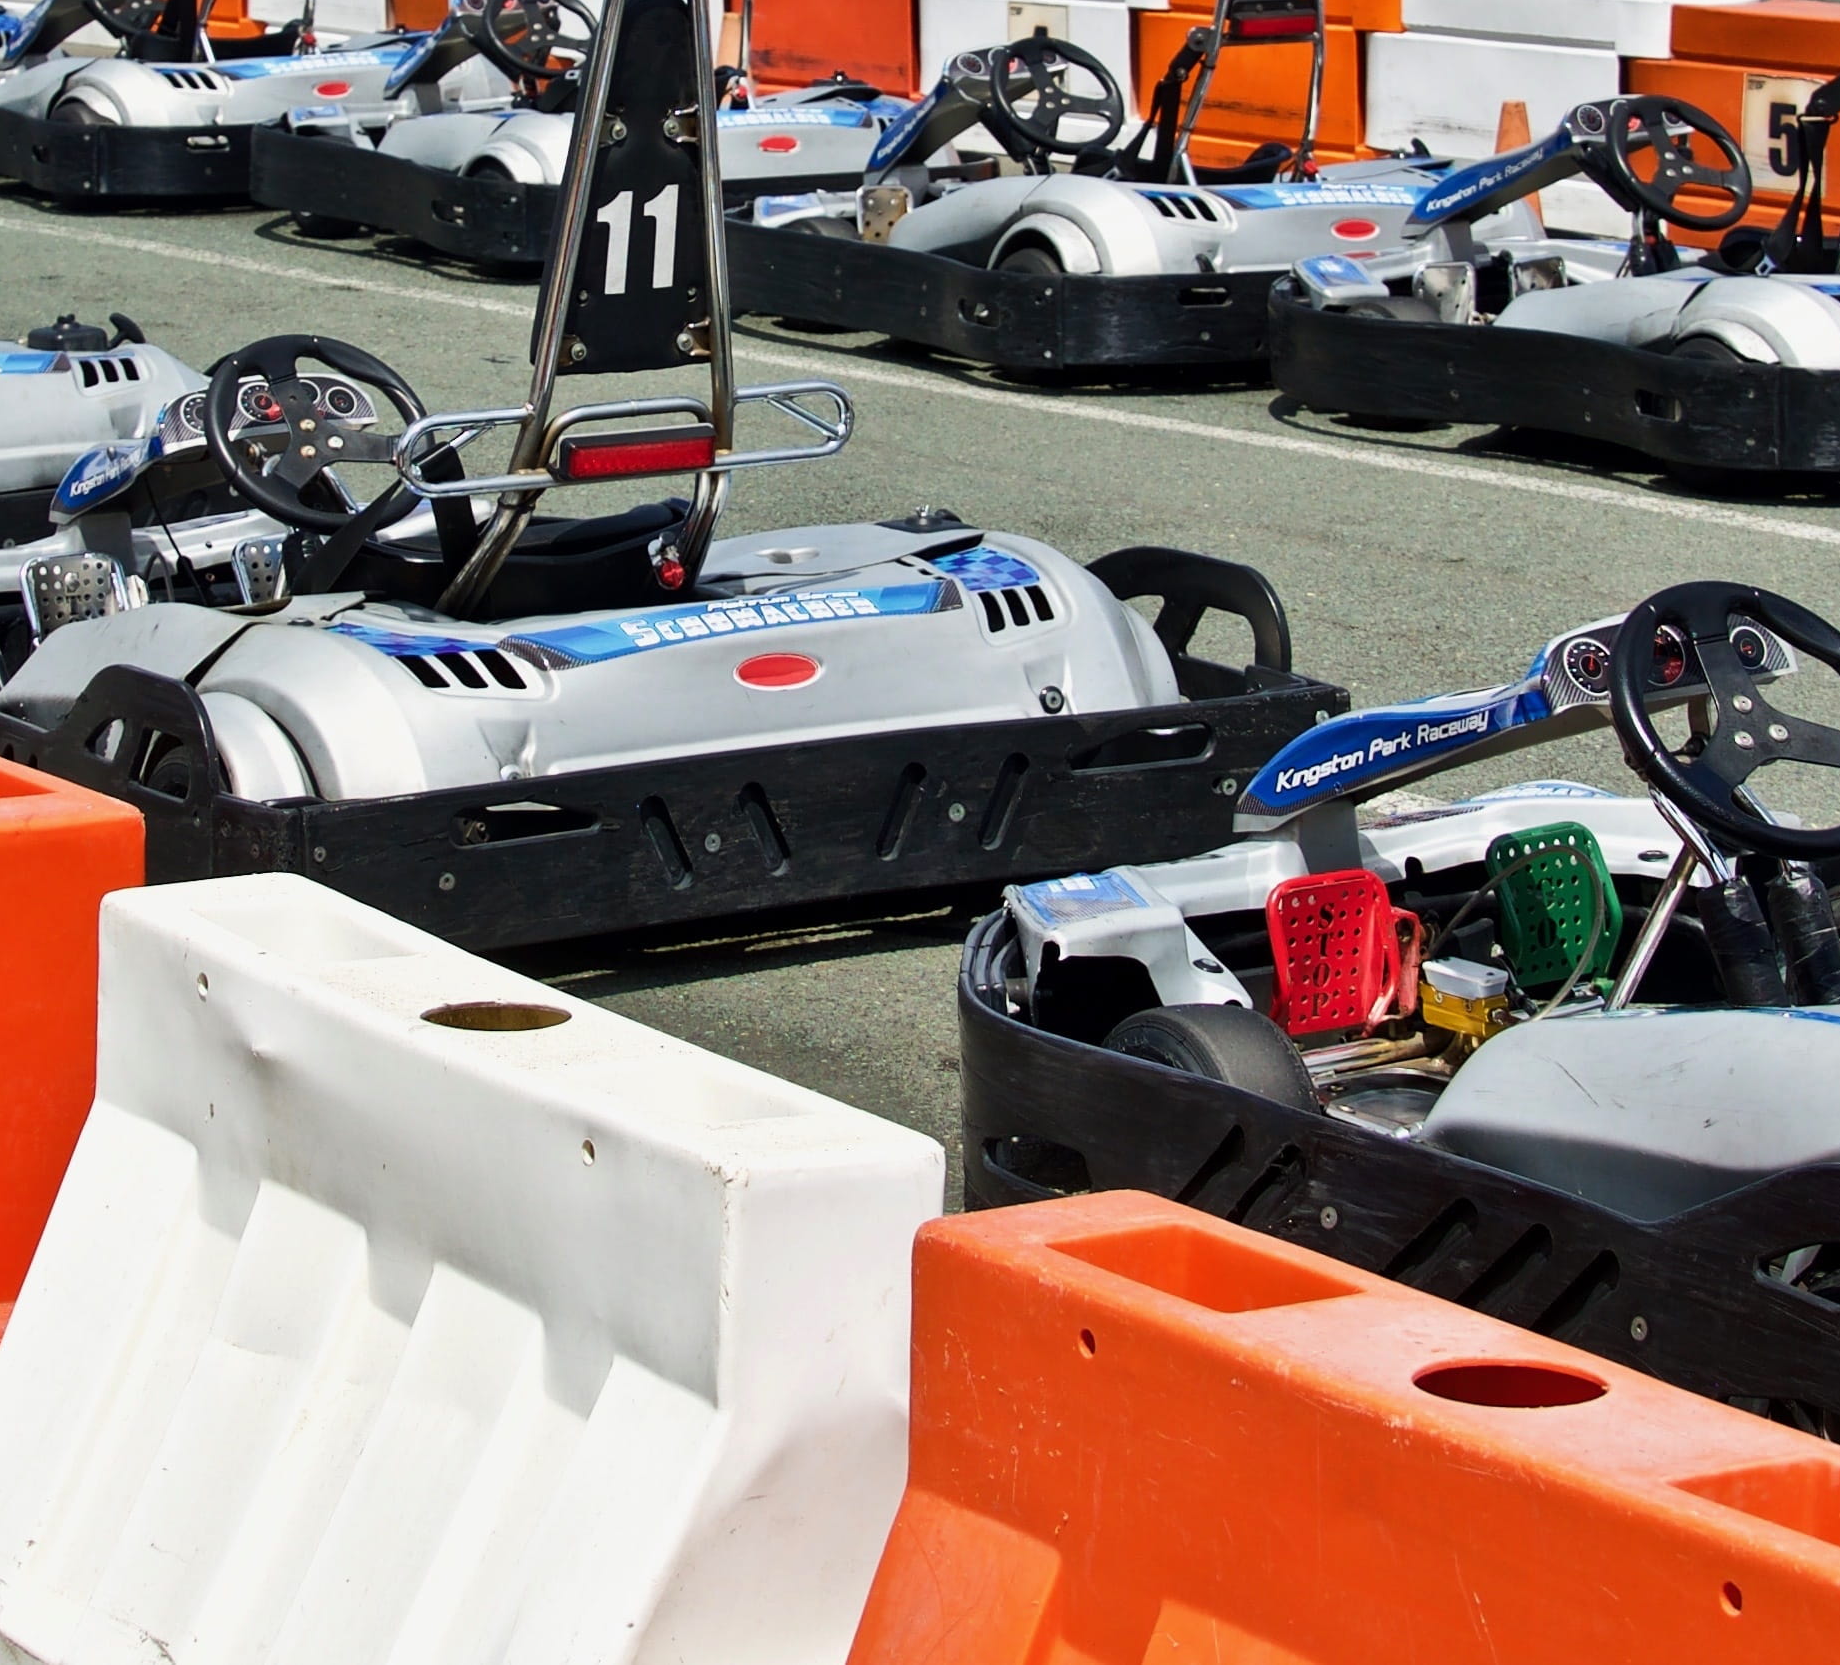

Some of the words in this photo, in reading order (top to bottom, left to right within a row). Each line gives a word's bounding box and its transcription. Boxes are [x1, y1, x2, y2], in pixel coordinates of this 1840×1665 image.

[1769, 102, 1800, 177] 5
[596, 183, 680, 295] 11
[1275, 749, 1365, 793] Kingston
[1367, 732, 1412, 762] Park
[1416, 710, 1490, 747] Raceway
